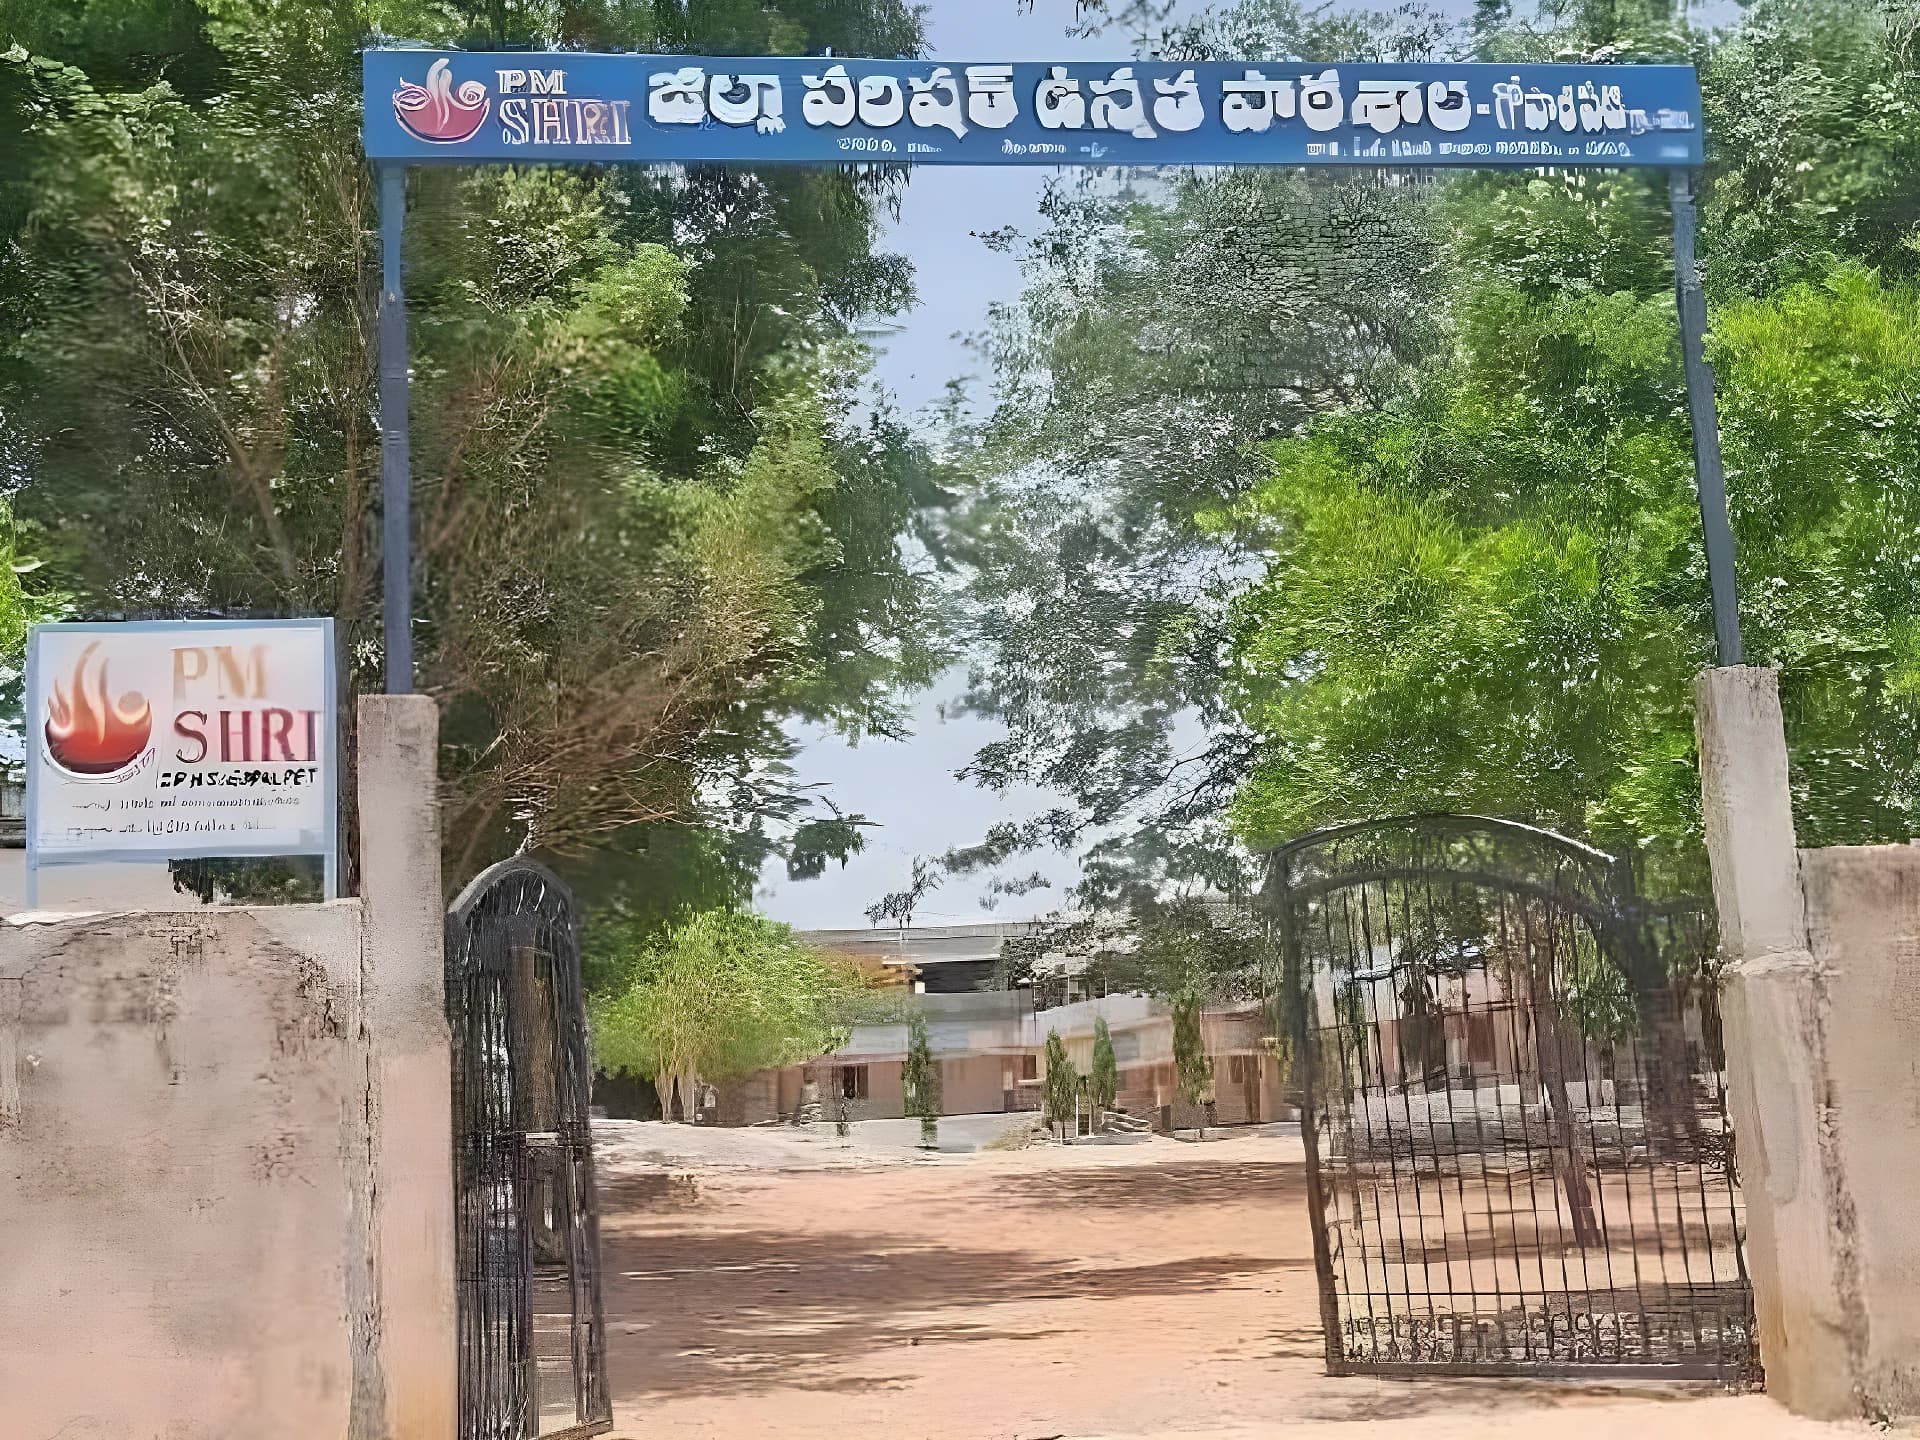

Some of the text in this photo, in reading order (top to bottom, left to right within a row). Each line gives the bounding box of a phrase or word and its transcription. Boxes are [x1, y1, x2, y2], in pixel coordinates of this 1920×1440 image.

[495, 69, 568, 95] PM
[499, 98, 632, 145] SHRI
[172, 646, 271, 700] PM
[174, 707, 318, 763] SHRI
